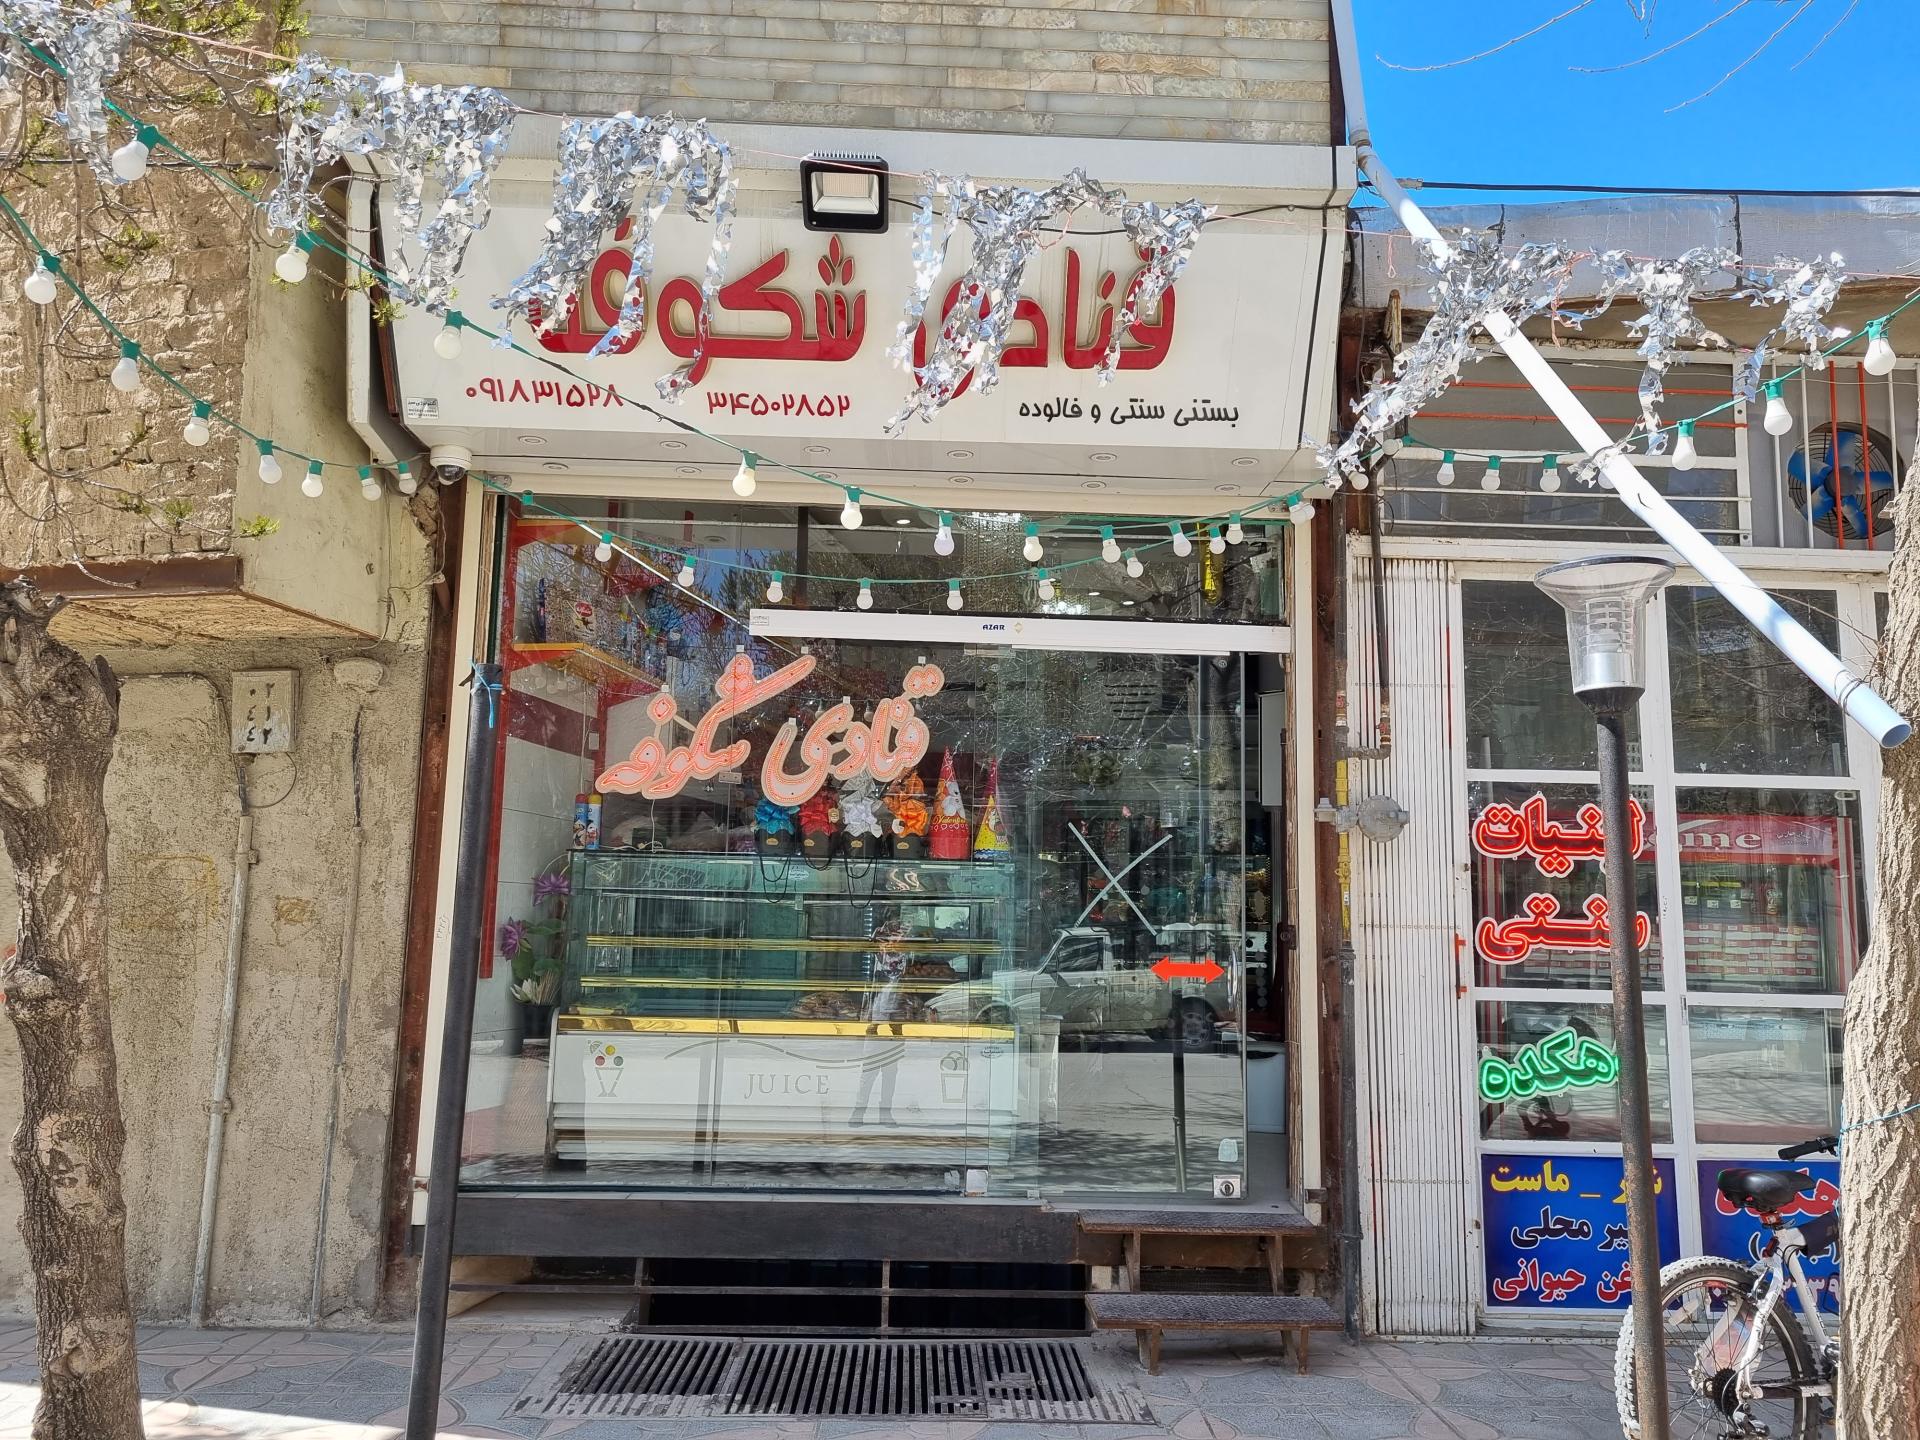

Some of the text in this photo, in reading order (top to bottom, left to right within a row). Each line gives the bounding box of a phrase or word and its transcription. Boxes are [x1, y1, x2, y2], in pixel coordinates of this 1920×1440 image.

[706, 391, 851, 417] ۳۴۵۰۲۸۵۲
[1018, 396, 1240, 428] بستنی سنتی و فالوده
[597, 654, 945, 805] قنادی شکوفه
[743, 1073, 831, 1100] JUICE
[1489, 1159, 1571, 1193] ماست
[1511, 1205, 1593, 1249] محلی
[1493, 1257, 1586, 1303] حیوانی
